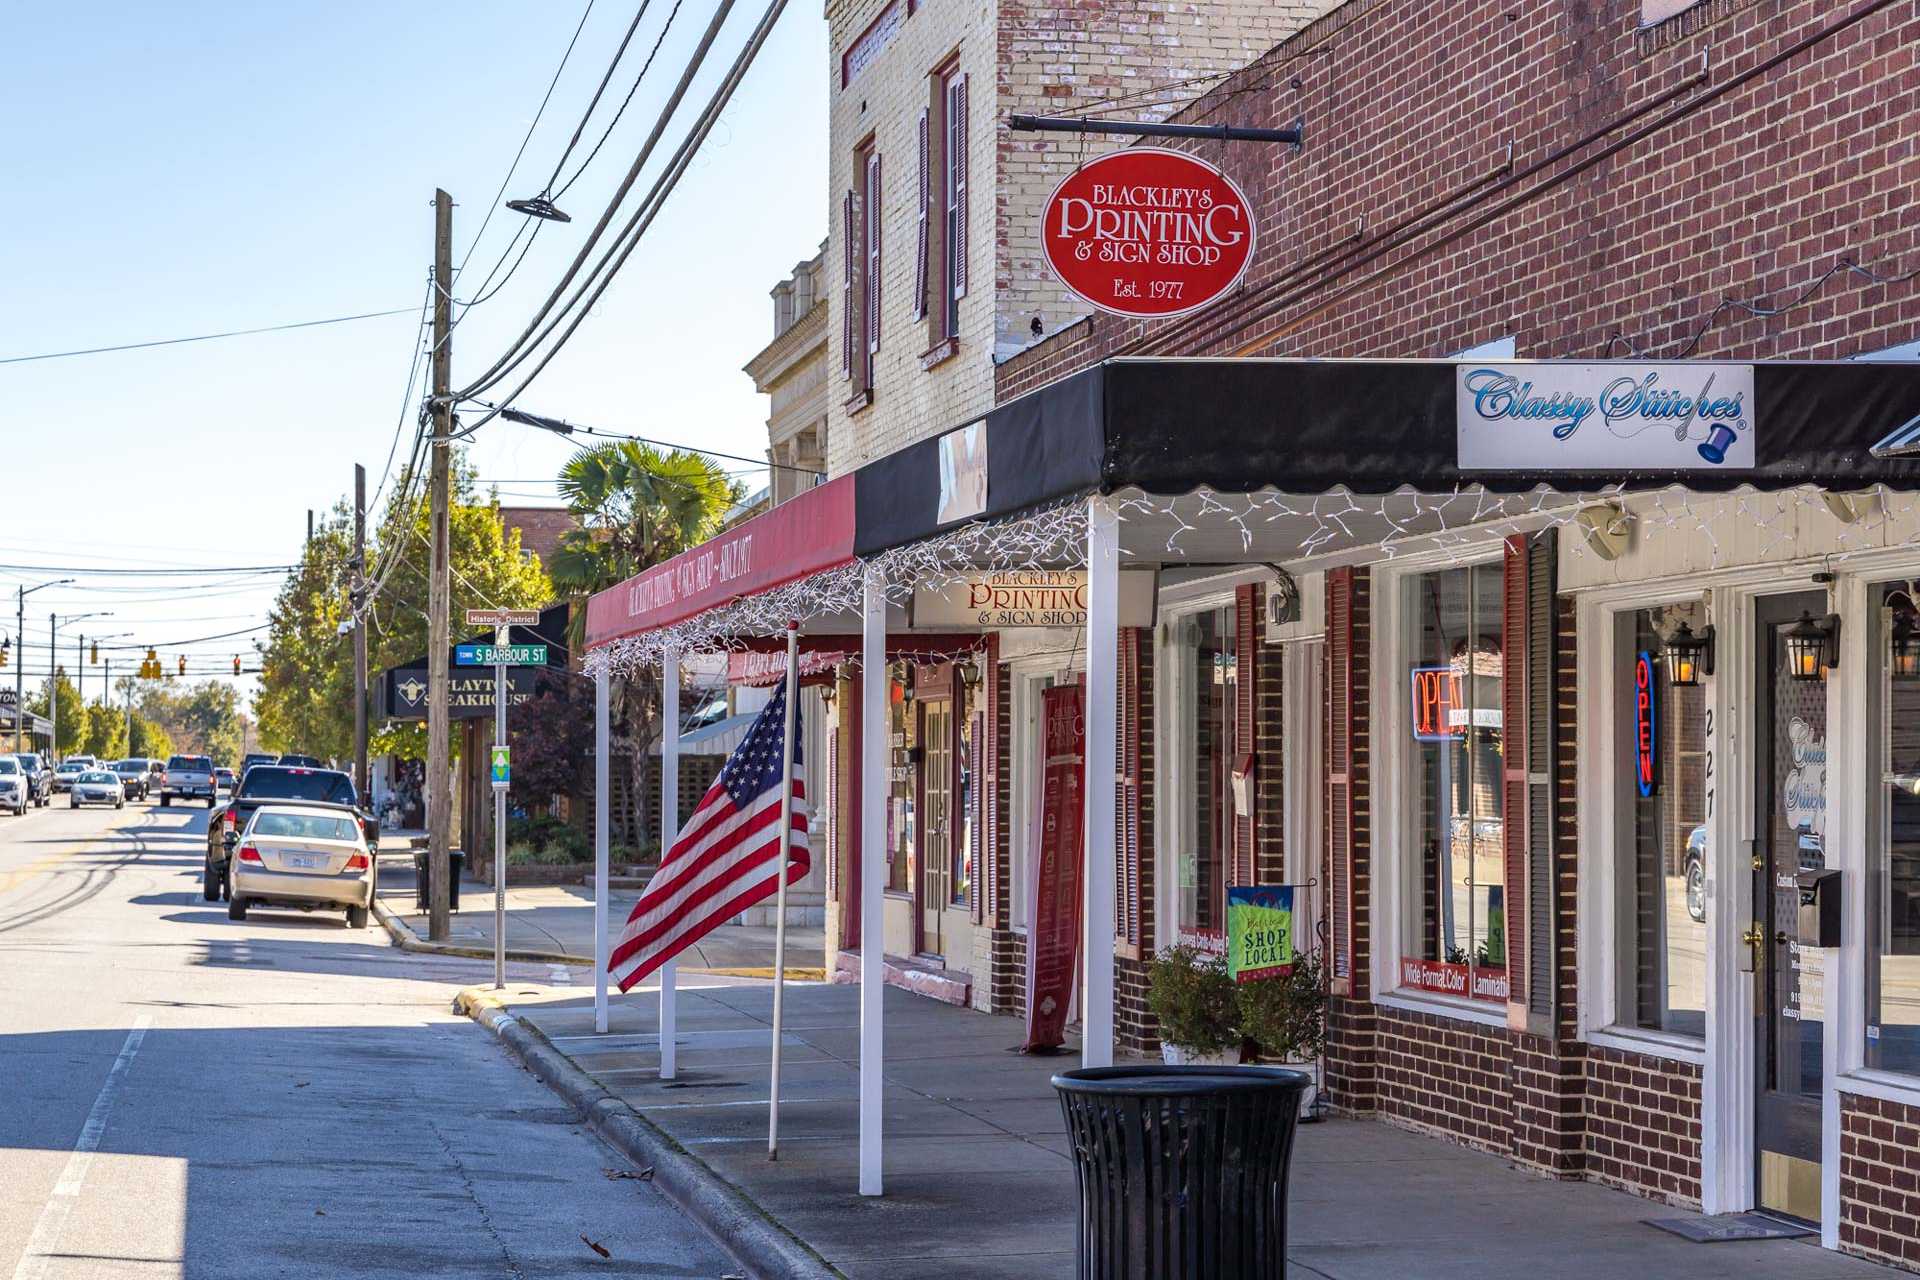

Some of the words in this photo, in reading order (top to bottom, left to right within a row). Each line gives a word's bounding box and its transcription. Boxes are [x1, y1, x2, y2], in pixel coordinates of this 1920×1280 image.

[1092, 184, 1213, 209] BLACKLEY'S
[1057, 198, 1244, 246] PRINTING
[1075, 240, 1094, 261] &
[1098, 241, 1151, 264] SIGN
[1156, 244, 1221, 266] SHOP
[1113, 279, 1142, 298] Est.
[1149, 280, 1184, 299] 1977
[1464, 368, 1596, 441] Classy
[1599, 371, 1745, 437] Stitches
[992, 571, 1077, 586] BLACKLEY'S
[470, 615, 502, 623] Historic
[505, 615, 535, 623] District
[978, 611, 992, 625] &
[997, 611, 1035, 625] SIGN
[1040, 611, 1088, 625] SHOP
[476, 648, 483, 662] S
[485, 648, 530, 662] BARBOUR
[532, 648, 545, 662] ST
[447, 679, 515, 691] LAYTN
[1413, 672, 1464, 734] OPEN
[1636, 659, 1653, 785] OPEN
[1244, 928, 1286, 949] SHOP
[1244, 945, 1286, 966] LOCAL
[1404, 963, 1421, 984] Wide
[1446, 968, 1466, 991] Color
